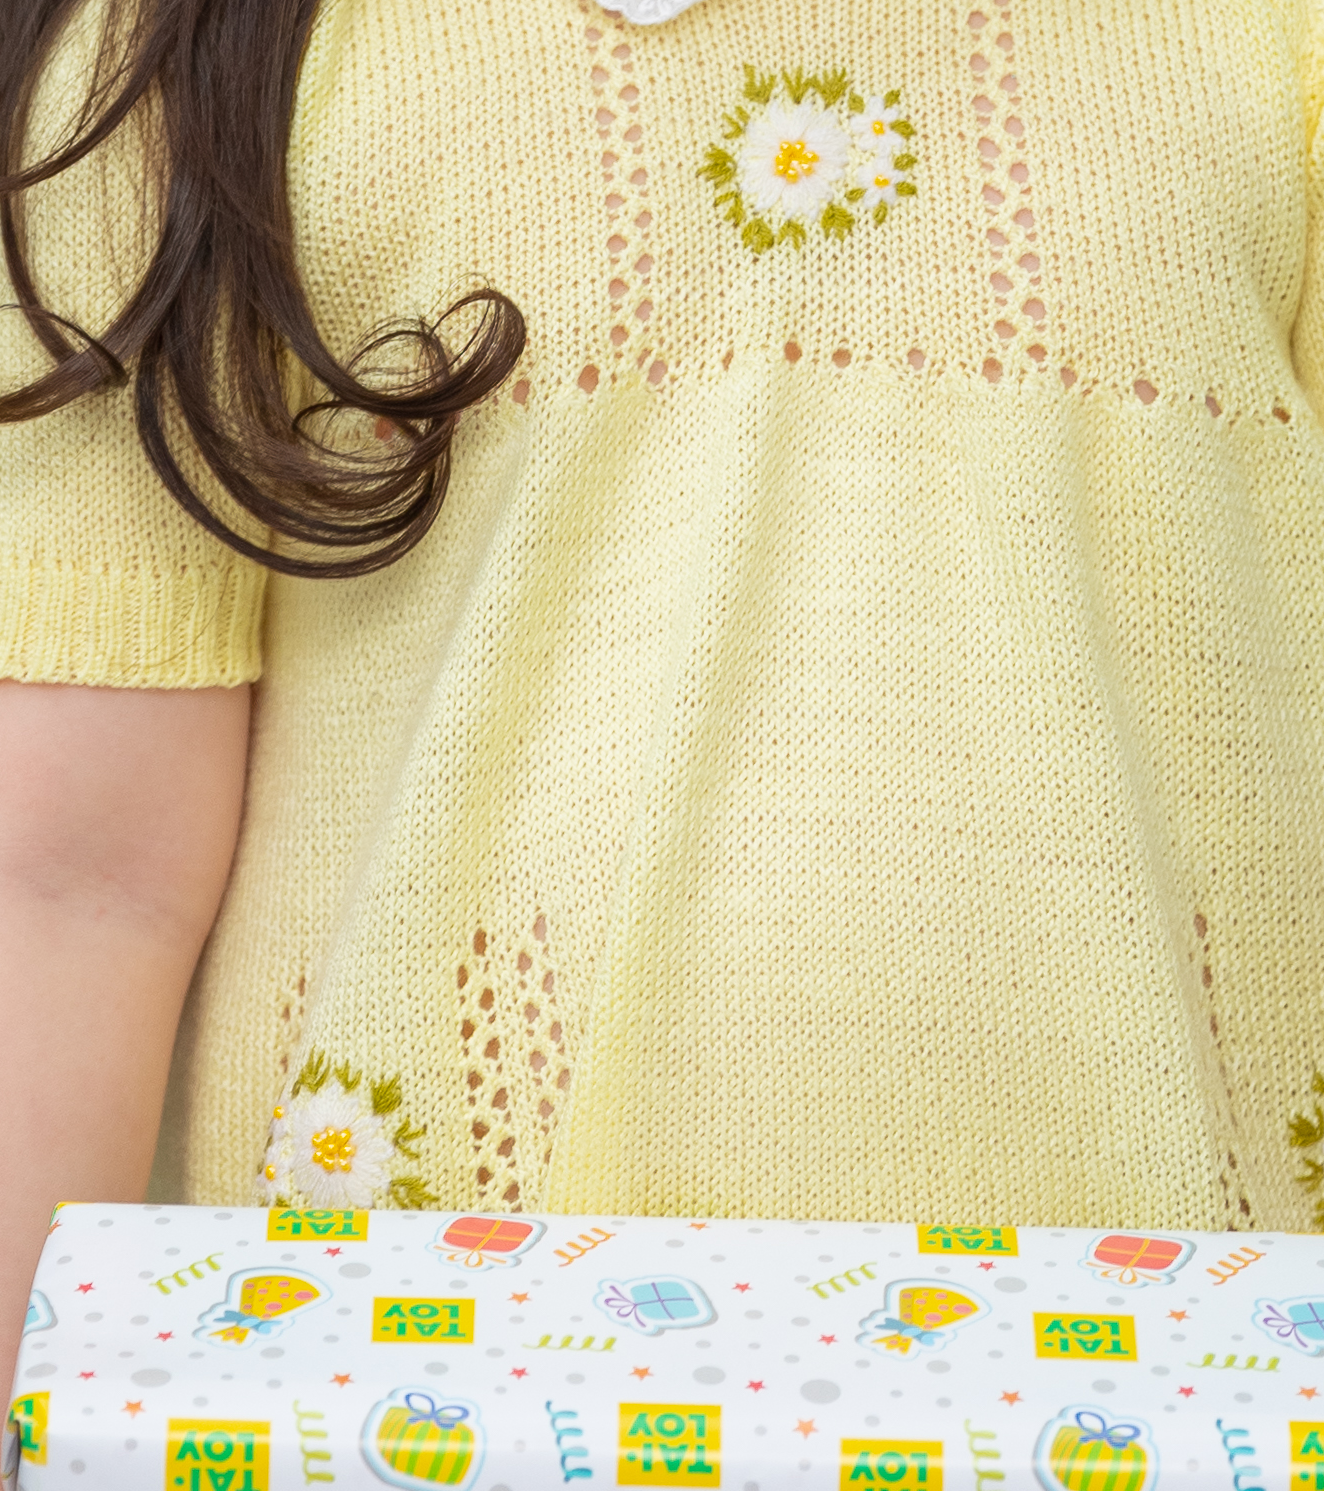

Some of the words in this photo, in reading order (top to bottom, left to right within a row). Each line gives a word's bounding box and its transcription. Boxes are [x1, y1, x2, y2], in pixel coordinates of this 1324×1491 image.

[384, 1304, 460, 1319] LOY
[1045, 1320, 1121, 1336] LOY
[629, 1413, 706, 1438] LOY
[177, 1432, 255, 1462] LOY
[851, 1452, 928, 1482] LOY
